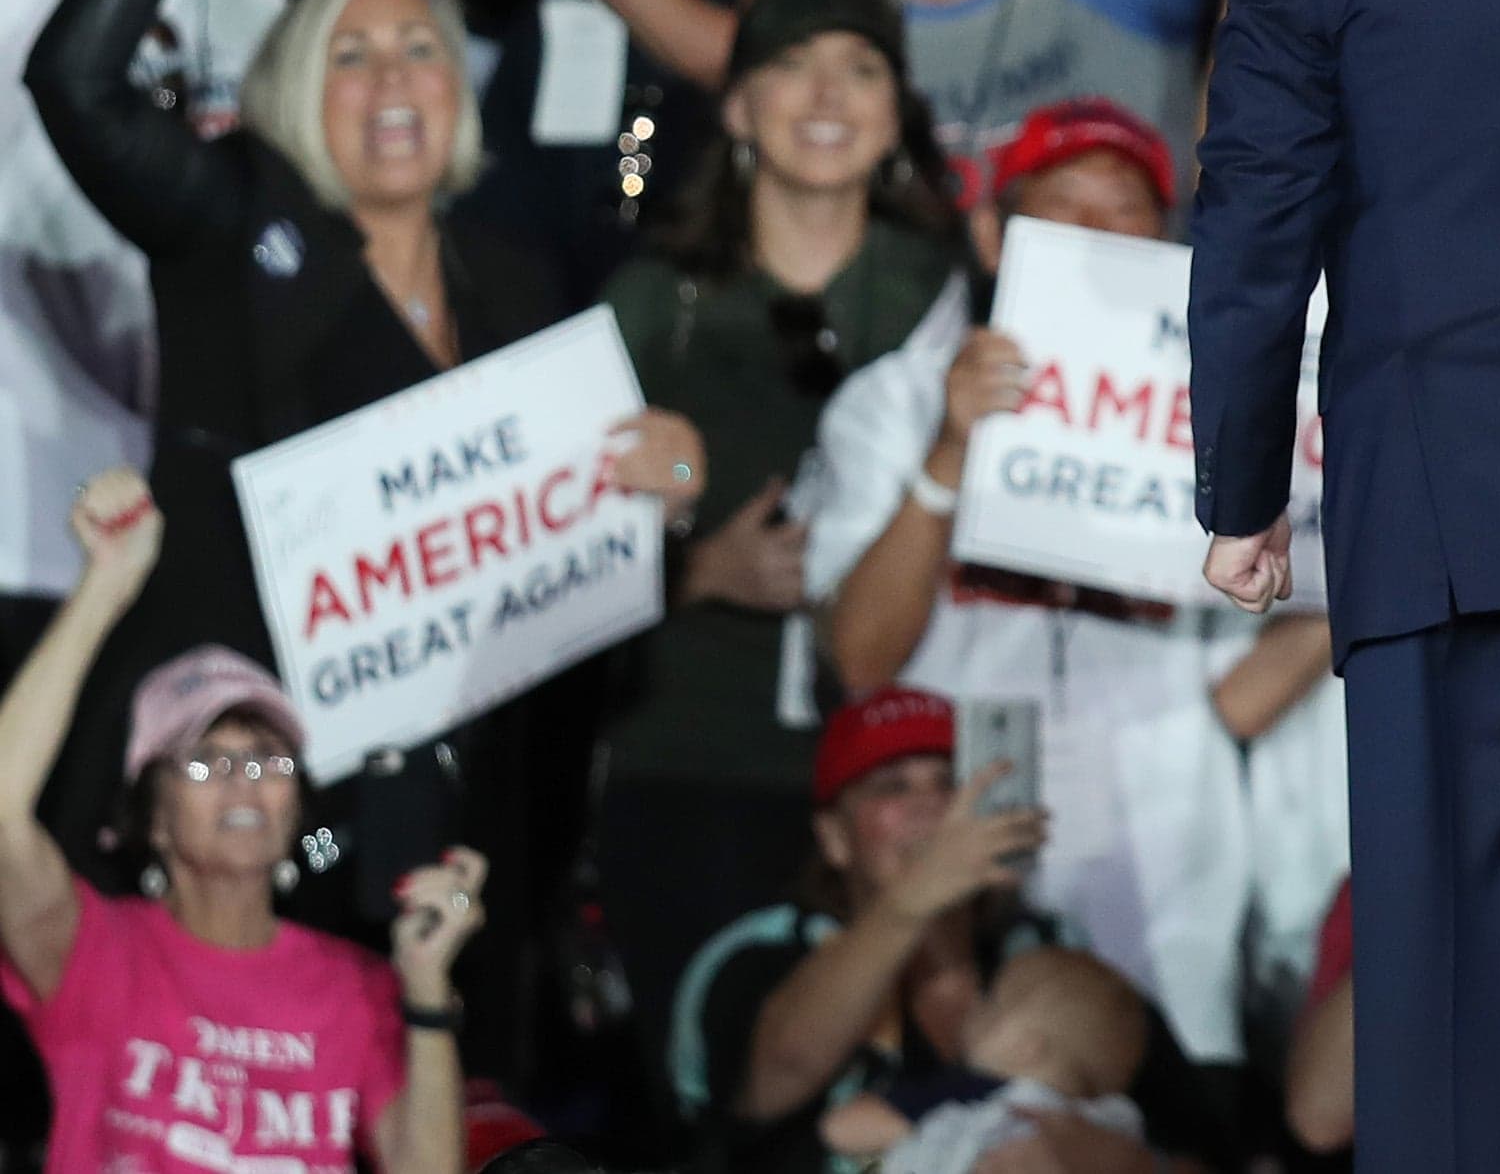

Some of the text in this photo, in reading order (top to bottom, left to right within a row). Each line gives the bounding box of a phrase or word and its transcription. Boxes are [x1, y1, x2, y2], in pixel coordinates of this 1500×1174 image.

[304, 452, 636, 643] AMERICA
[376, 415, 529, 513] MAKE
[310, 522, 638, 708] GREAT AGAIN
